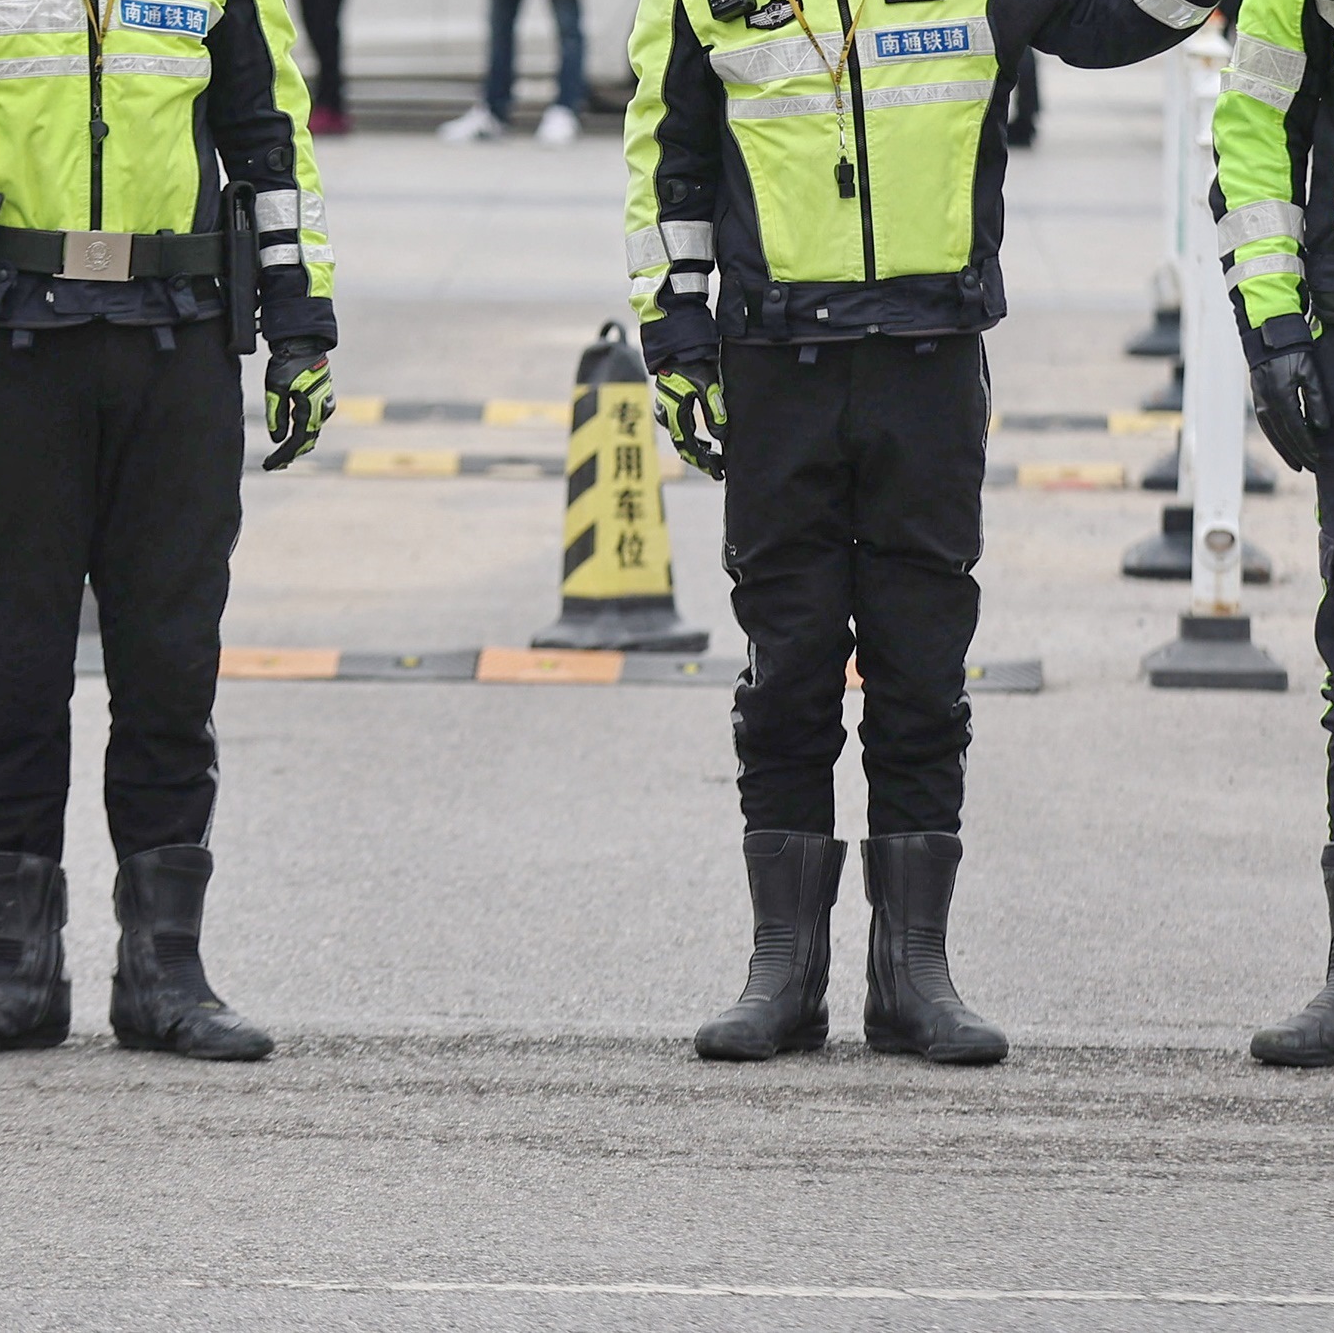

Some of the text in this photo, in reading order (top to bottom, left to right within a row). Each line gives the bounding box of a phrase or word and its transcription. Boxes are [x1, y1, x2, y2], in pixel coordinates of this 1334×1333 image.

[124, 1, 205, 32] 南通铁骑
[880, 28, 965, 55] 南通铁骑
